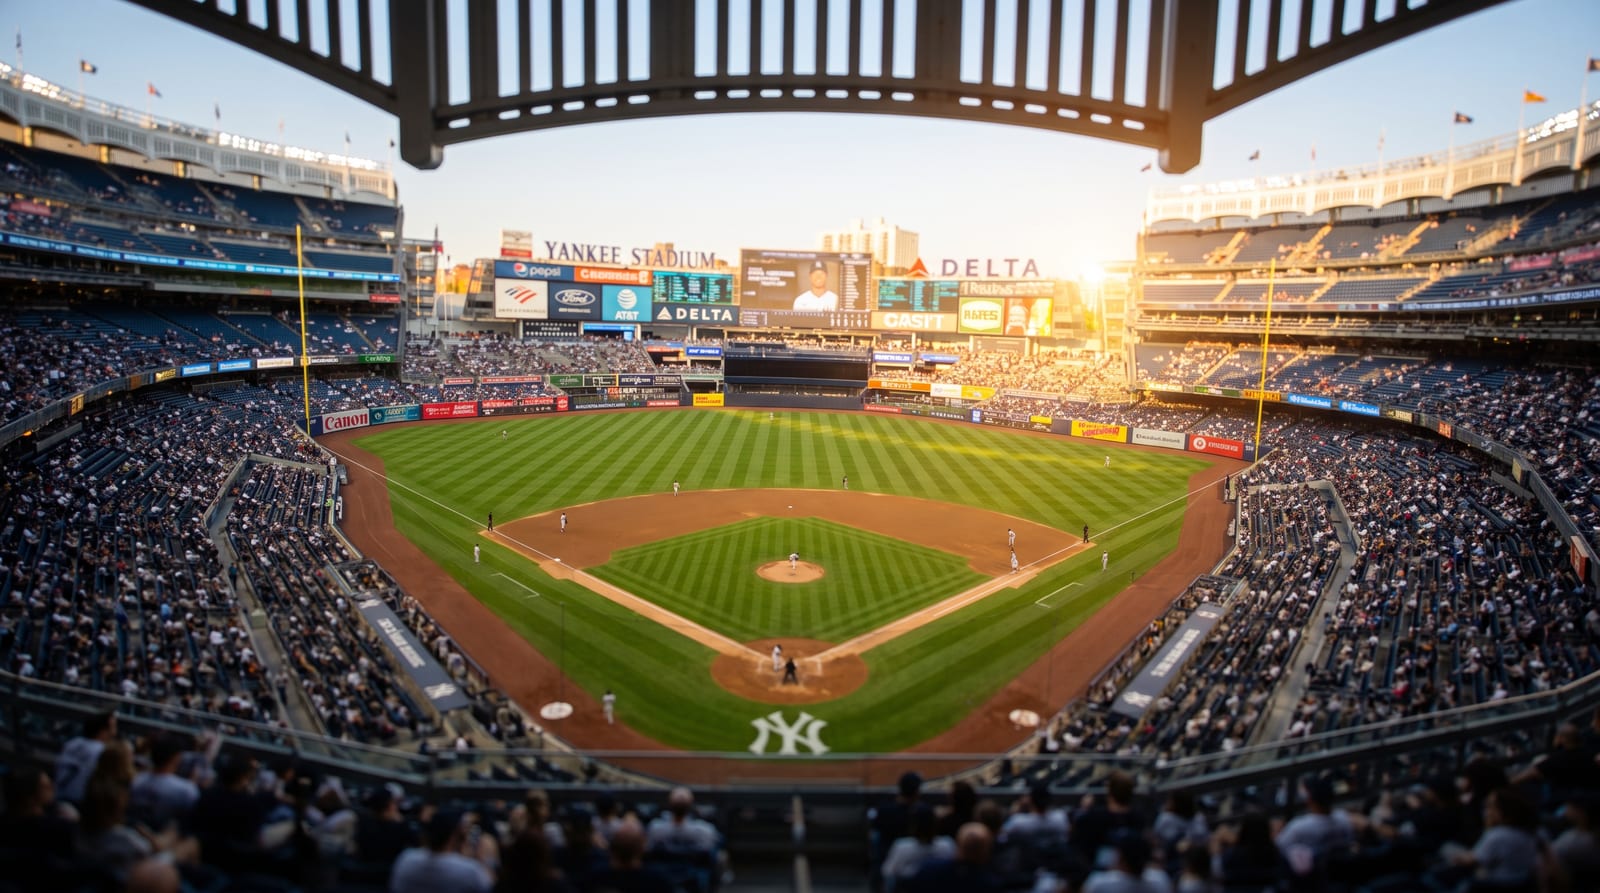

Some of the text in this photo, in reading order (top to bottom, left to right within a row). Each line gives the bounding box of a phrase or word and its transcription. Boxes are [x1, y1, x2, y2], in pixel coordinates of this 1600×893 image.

[545, 241, 716, 269] YANKEE STADIUM
[529, 266, 561, 278] pepsi
[942, 258, 1040, 278] DELTA
[561, 292, 587, 303] Ford
[614, 311, 639, 321] AT&T
[675, 307, 733, 322] DELTA
[324, 412, 369, 431] Canon
[749, 711, 830, 756] NY
